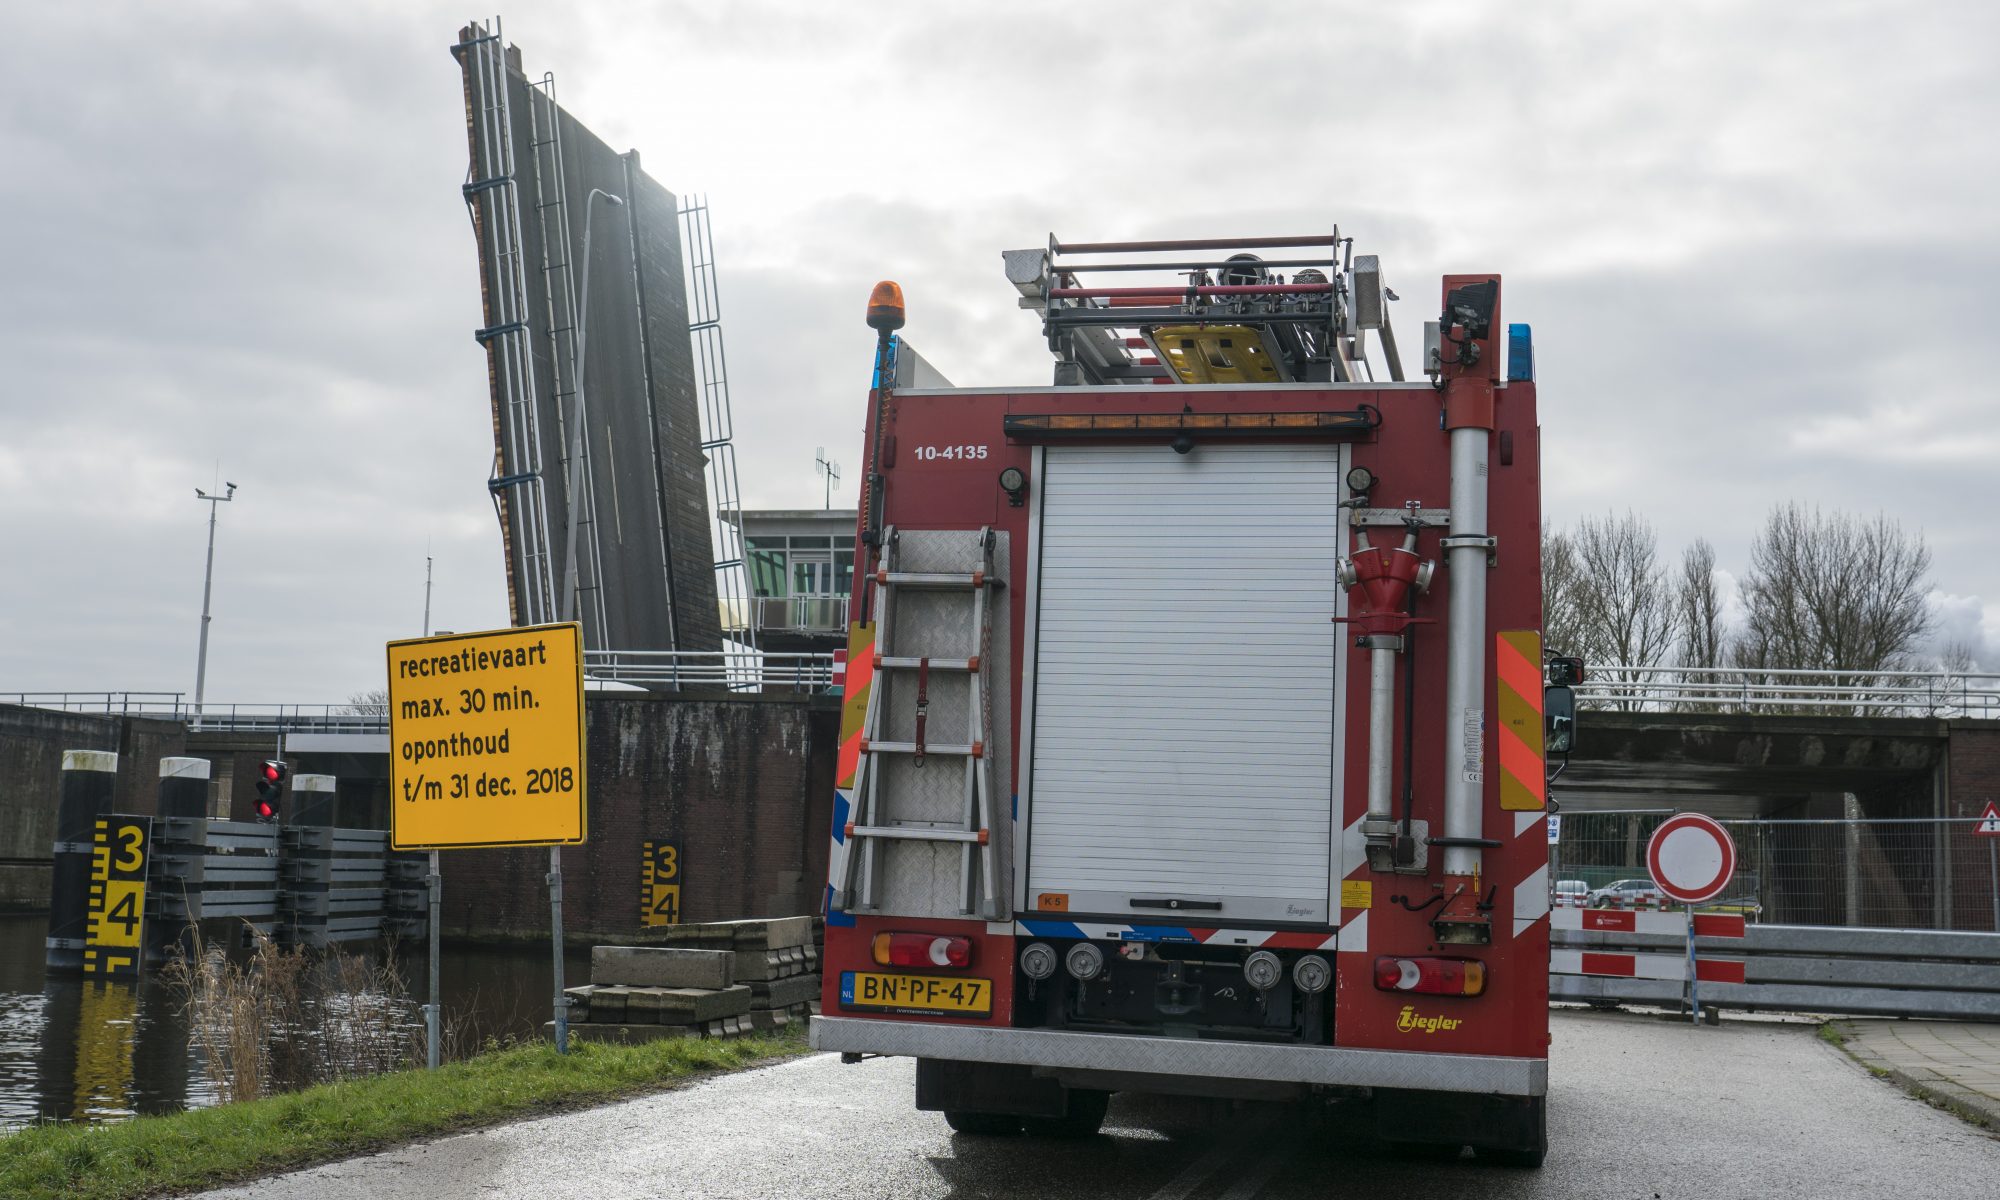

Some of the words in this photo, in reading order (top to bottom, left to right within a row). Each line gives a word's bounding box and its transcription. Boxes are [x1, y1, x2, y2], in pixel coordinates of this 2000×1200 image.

[914, 445, 988, 461] 10-4135
[400, 640, 547, 679] recreatievaart
[402, 696, 450, 720] max.
[459, 688, 486, 714] 30
[493, 685, 540, 712] min.
[402, 728, 510, 765] oponthoud
[403, 774, 443, 803] t/m
[450, 773, 469, 799] 31
[475, 772, 517, 797] dec.
[526, 766, 574, 795] 2018
[115, 825, 144, 872] 3
[657, 845, 677, 879] 3
[107, 892, 139, 936] 4
[653, 892, 677, 924] 4
[842, 990, 853, 999] NL
[1397, 1006, 1462, 1033] Ziegler
